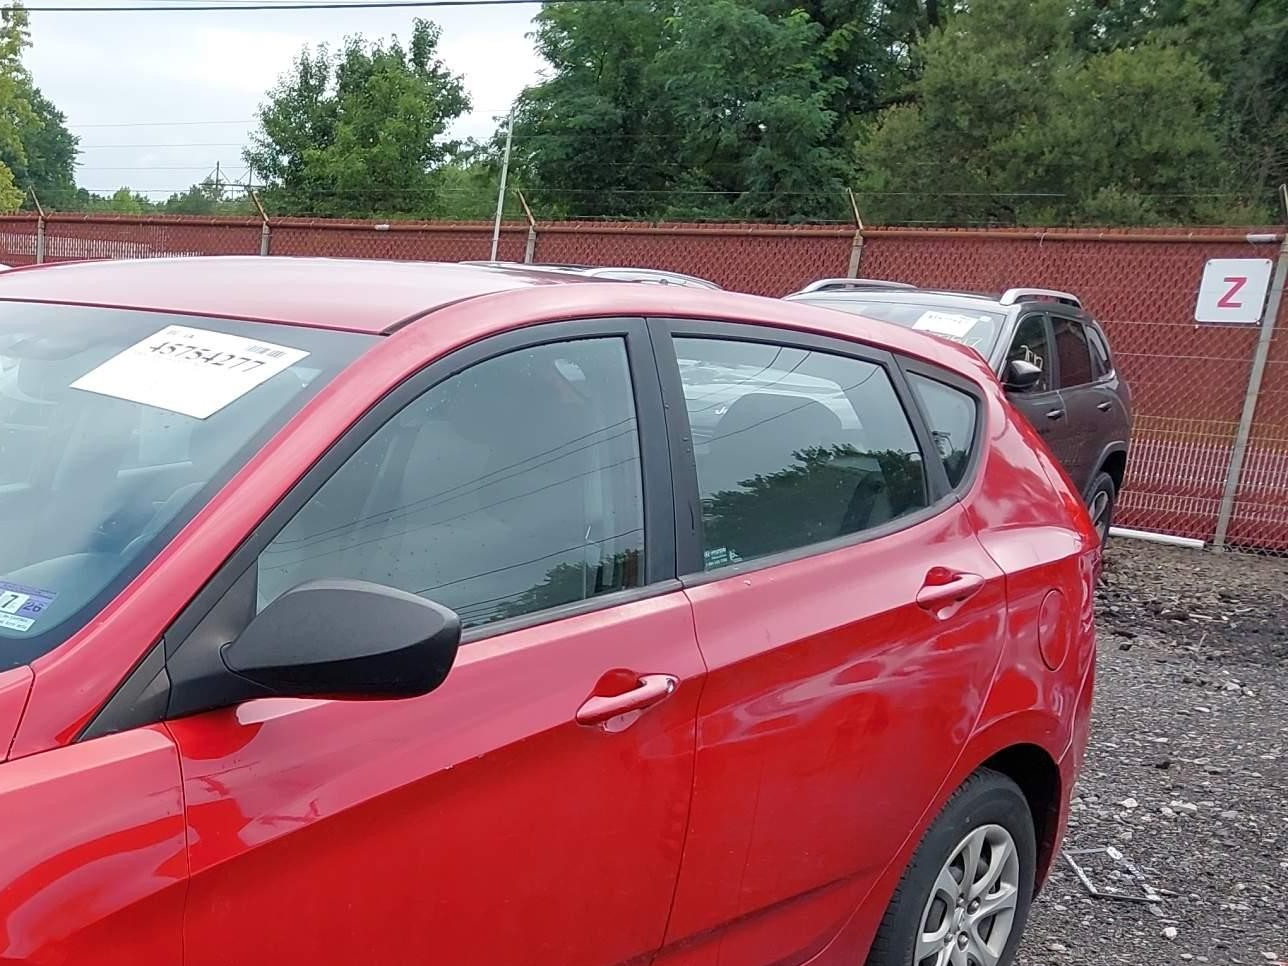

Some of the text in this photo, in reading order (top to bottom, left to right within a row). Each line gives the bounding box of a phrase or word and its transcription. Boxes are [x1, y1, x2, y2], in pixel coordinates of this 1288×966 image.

[1217, 277, 1248, 308] Z
[150, 342, 266, 372] 45754277
[1, 594, 18, 609] 7
[23, 601, 44, 613] 26
